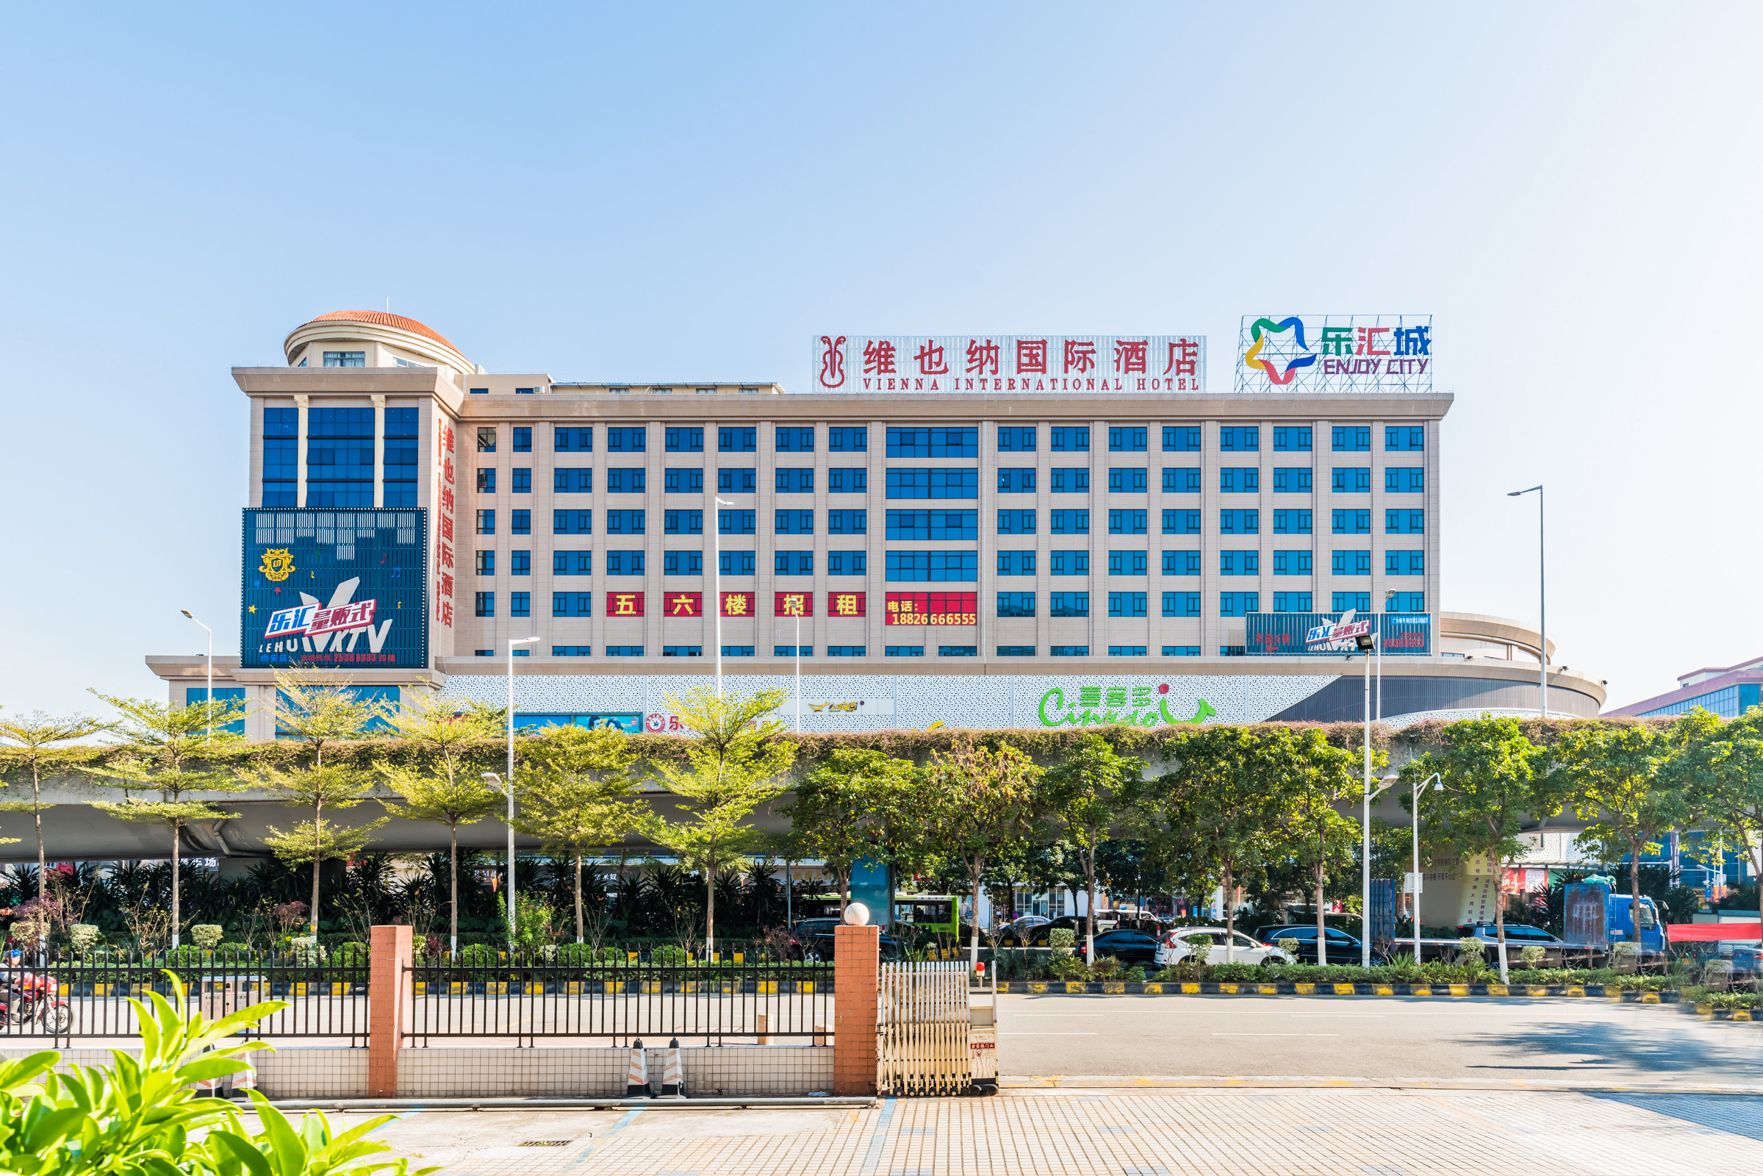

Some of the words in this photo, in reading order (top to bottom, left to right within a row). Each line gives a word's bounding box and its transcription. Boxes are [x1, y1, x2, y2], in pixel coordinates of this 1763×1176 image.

[1322, 325, 1432, 357] 乐汇城
[863, 338, 1199, 376] 维也纳国际酒店
[1324, 359, 1379, 375] ENJOY
[1386, 359, 1430, 375] CITY
[863, 377, 940, 392] VIENNA
[954, 377, 1124, 392] INTERNATIONAL
[1137, 377, 1200, 392] HOTEL
[441, 424, 455, 629] 维也纳国际酒店
[615, 594, 857, 616] 五六楼招租
[269, 602, 372, 633] 乐汇量贩式
[891, 613, 976, 625] 18826666555
[1254, 632, 1291, 644] 本座4楼
[1383, 638, 1403, 648] 2538
[334, 653, 355, 662] 2538
[1080, 686, 1152, 707] 喜客多
